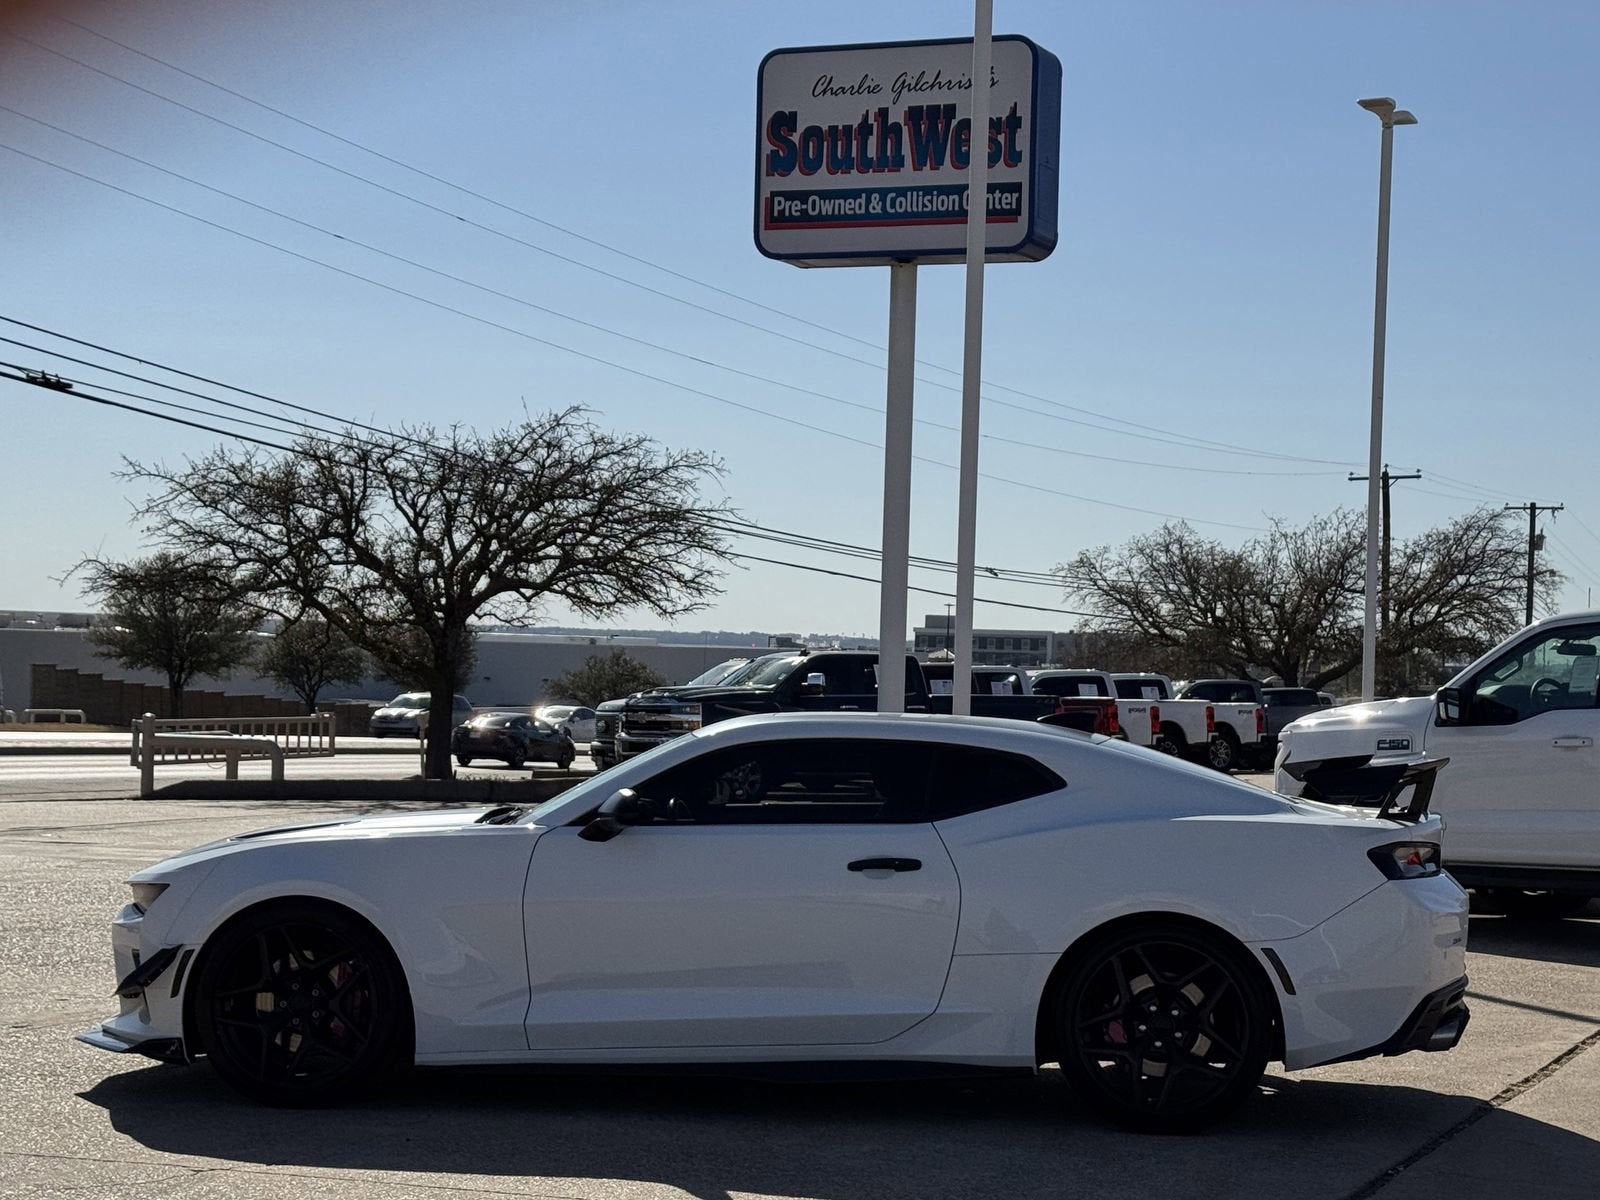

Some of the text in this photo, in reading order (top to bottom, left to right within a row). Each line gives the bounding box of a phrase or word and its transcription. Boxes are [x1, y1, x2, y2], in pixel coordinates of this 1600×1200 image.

[812, 73, 883, 98] Charlie
[773, 189, 1020, 217] Pre-Owned & Collision Cnter
